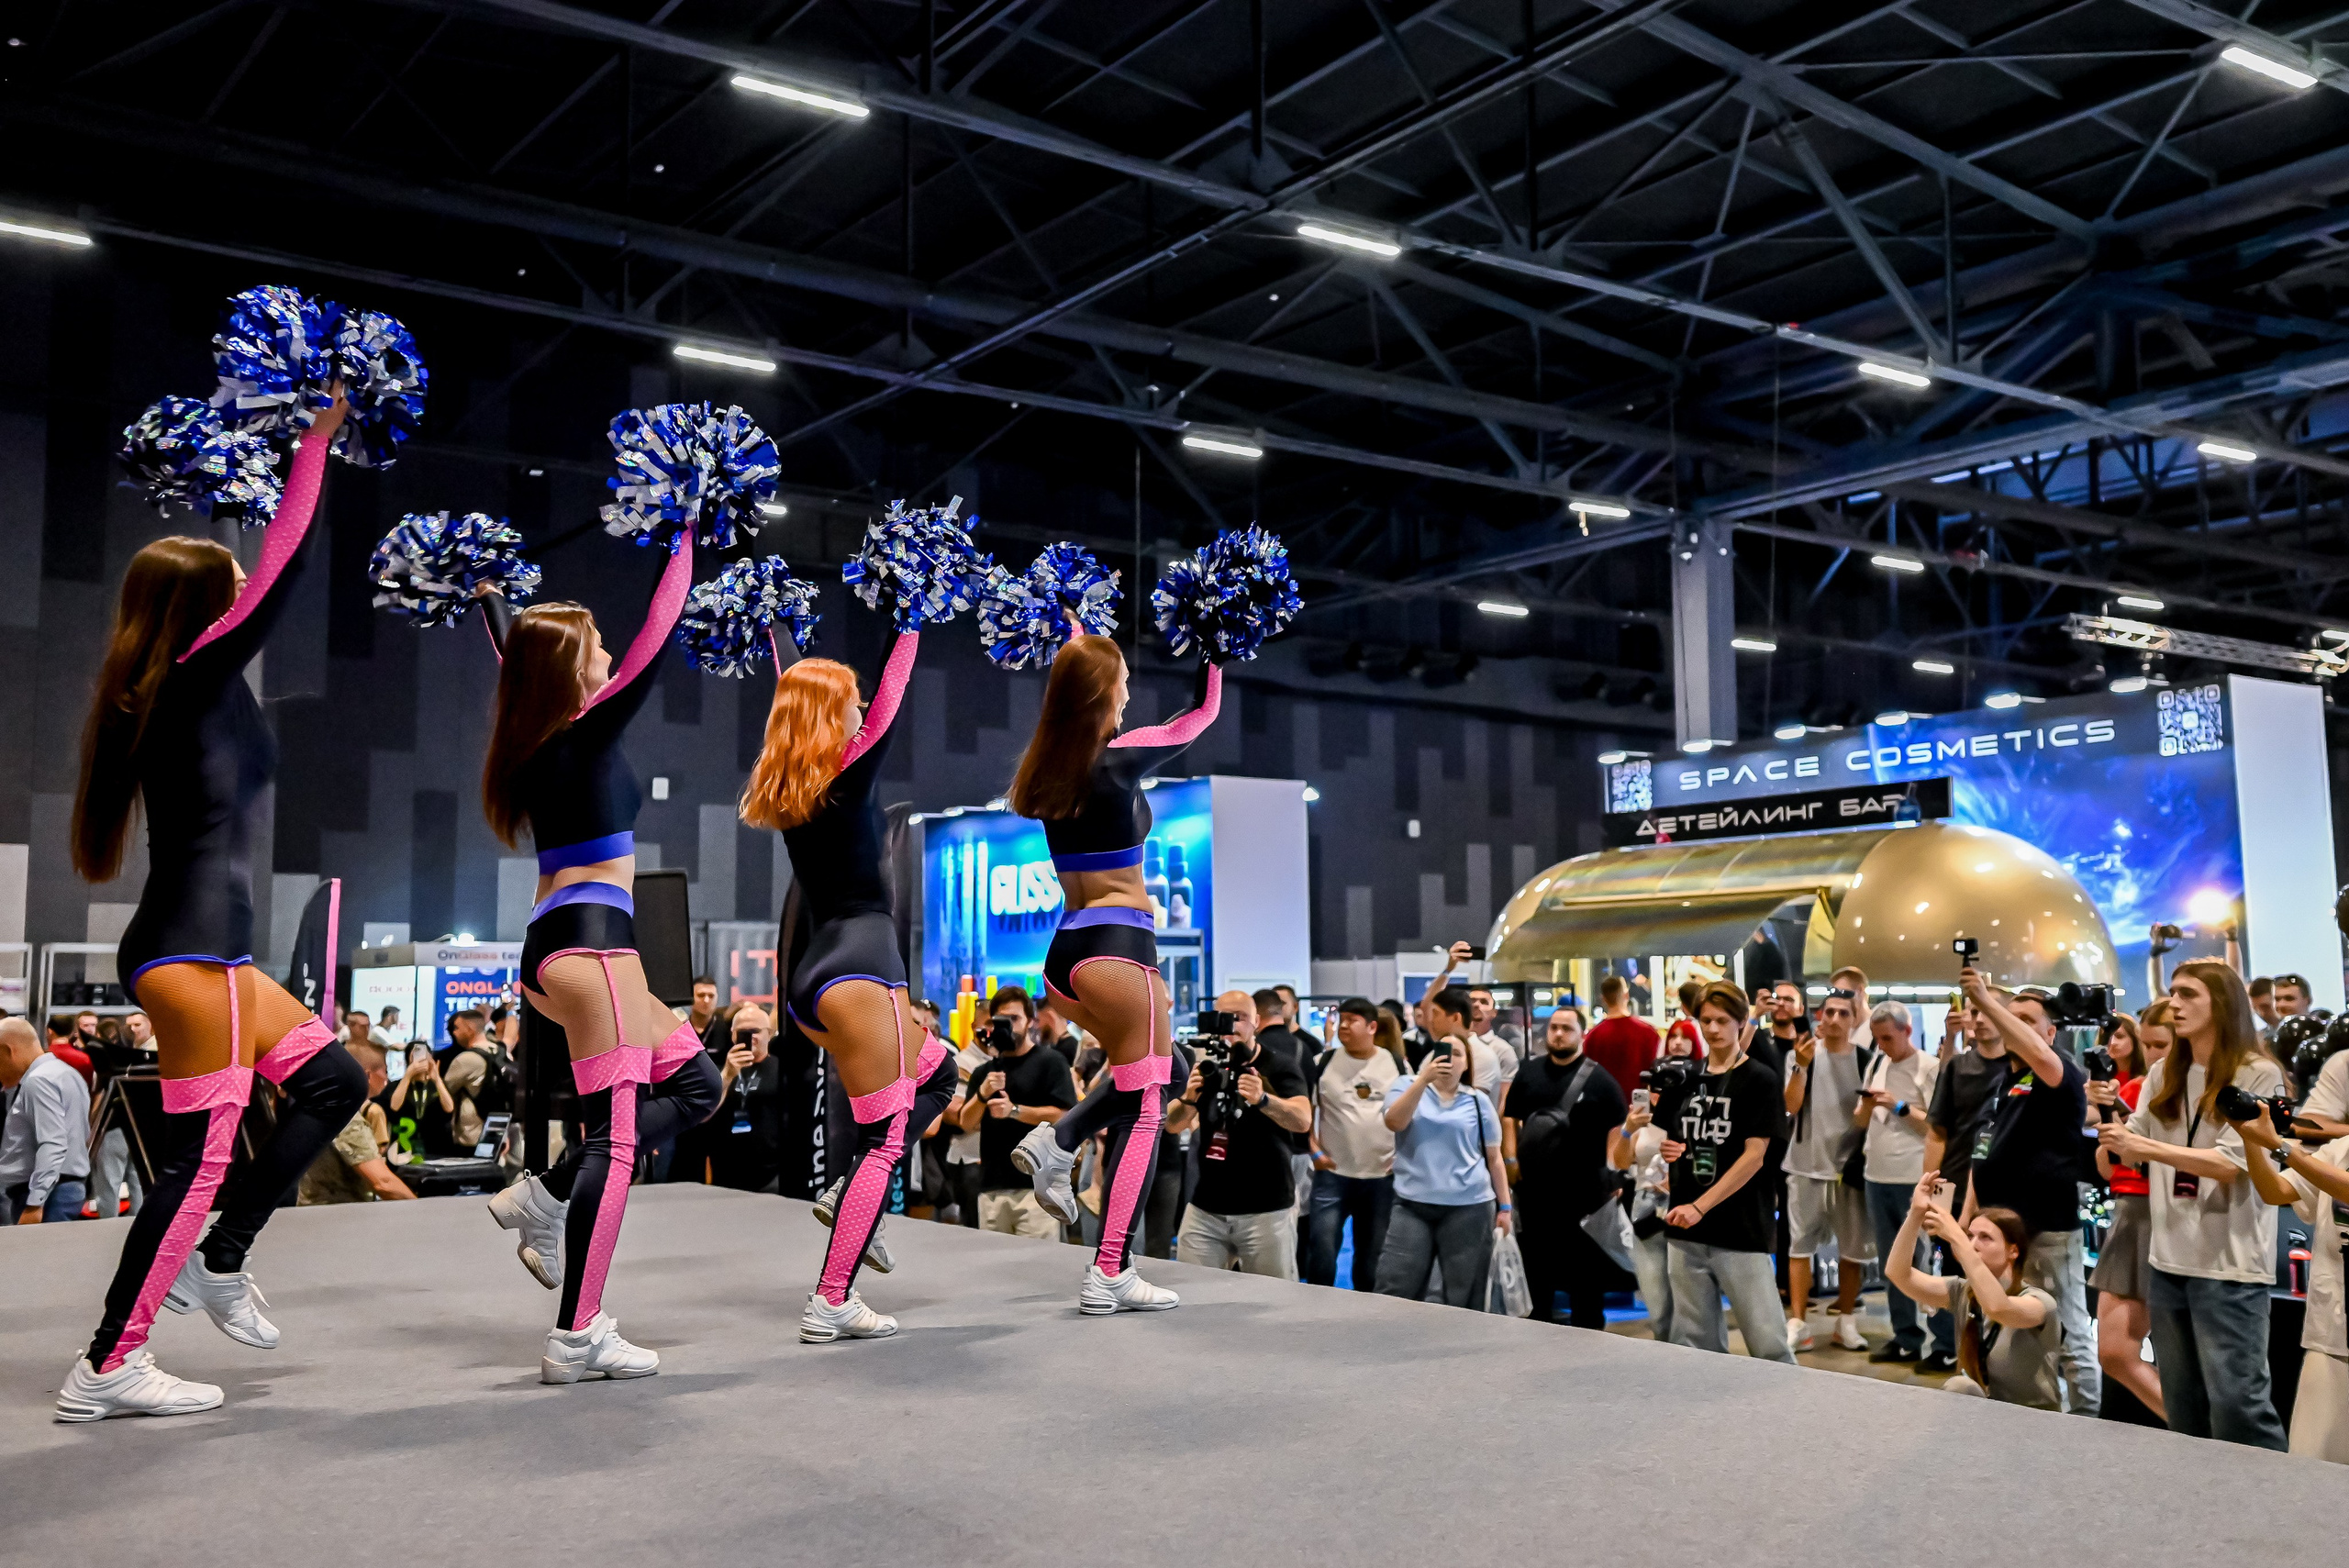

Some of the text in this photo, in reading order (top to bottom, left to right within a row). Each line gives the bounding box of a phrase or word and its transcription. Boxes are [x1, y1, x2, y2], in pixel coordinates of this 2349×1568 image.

[1679, 719, 2116, 790] SPACE COSMETICS
[1635, 802, 1822, 836] ДЕТЕЙЛИНГ
